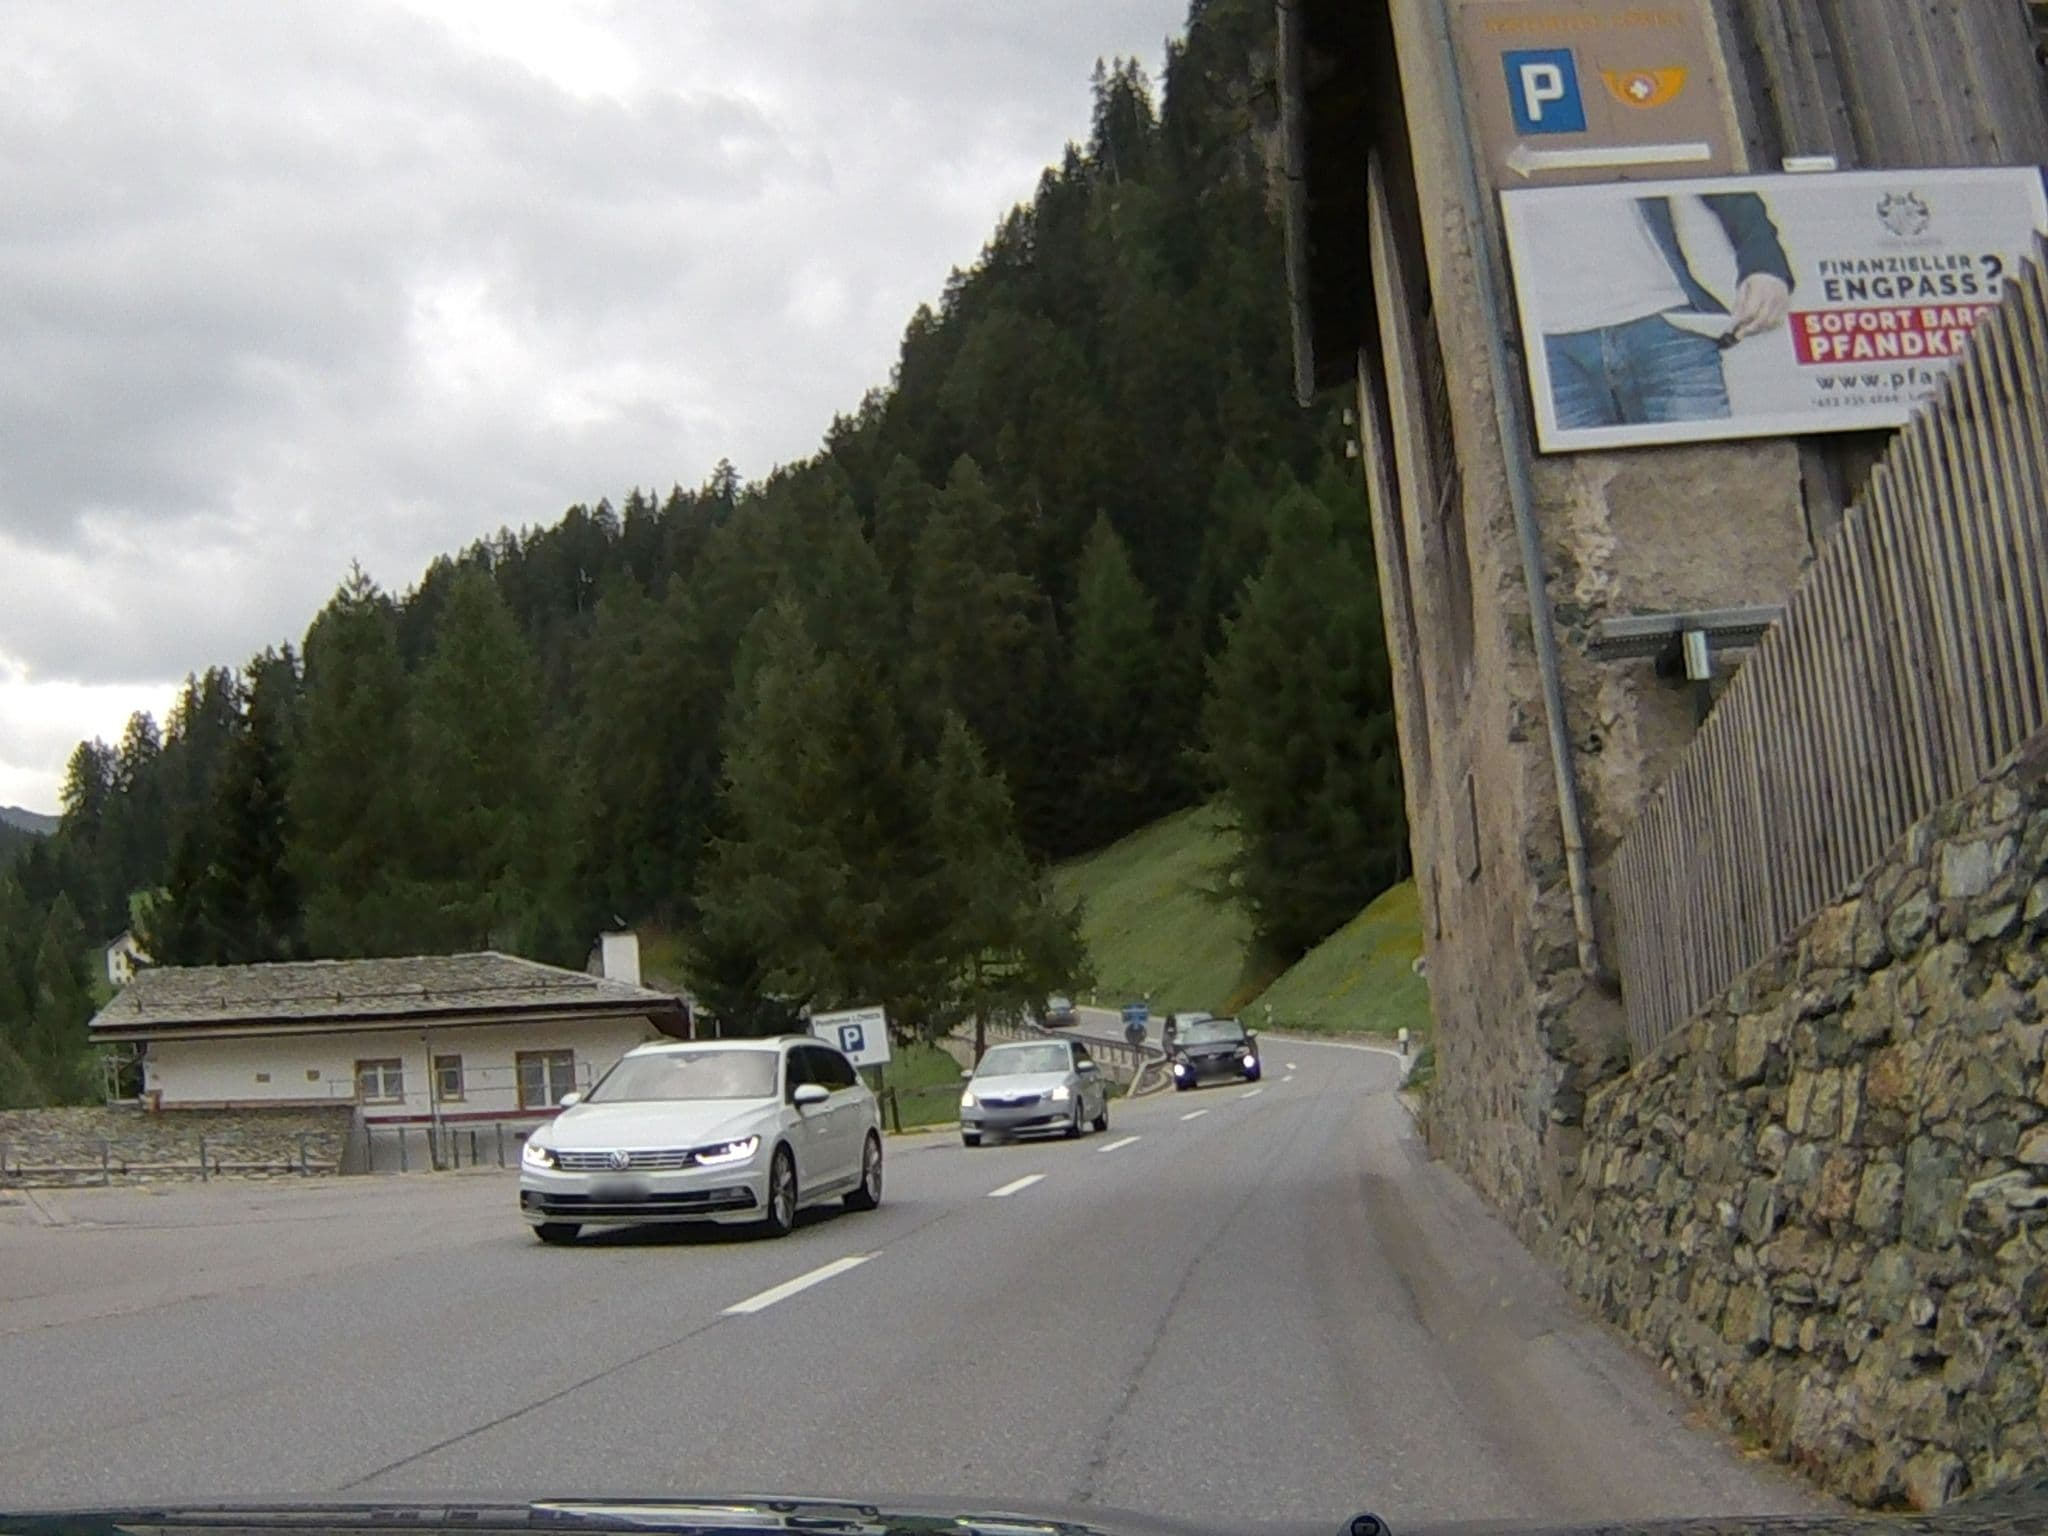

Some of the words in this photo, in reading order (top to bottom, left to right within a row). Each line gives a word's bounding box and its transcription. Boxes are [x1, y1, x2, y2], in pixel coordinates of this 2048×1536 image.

[1519, 63, 1564, 121] P
[1818, 254, 1973, 276] FINANZIELLER
[1804, 309, 1912, 334] SOFORT
[842, 1027, 861, 1051] P
